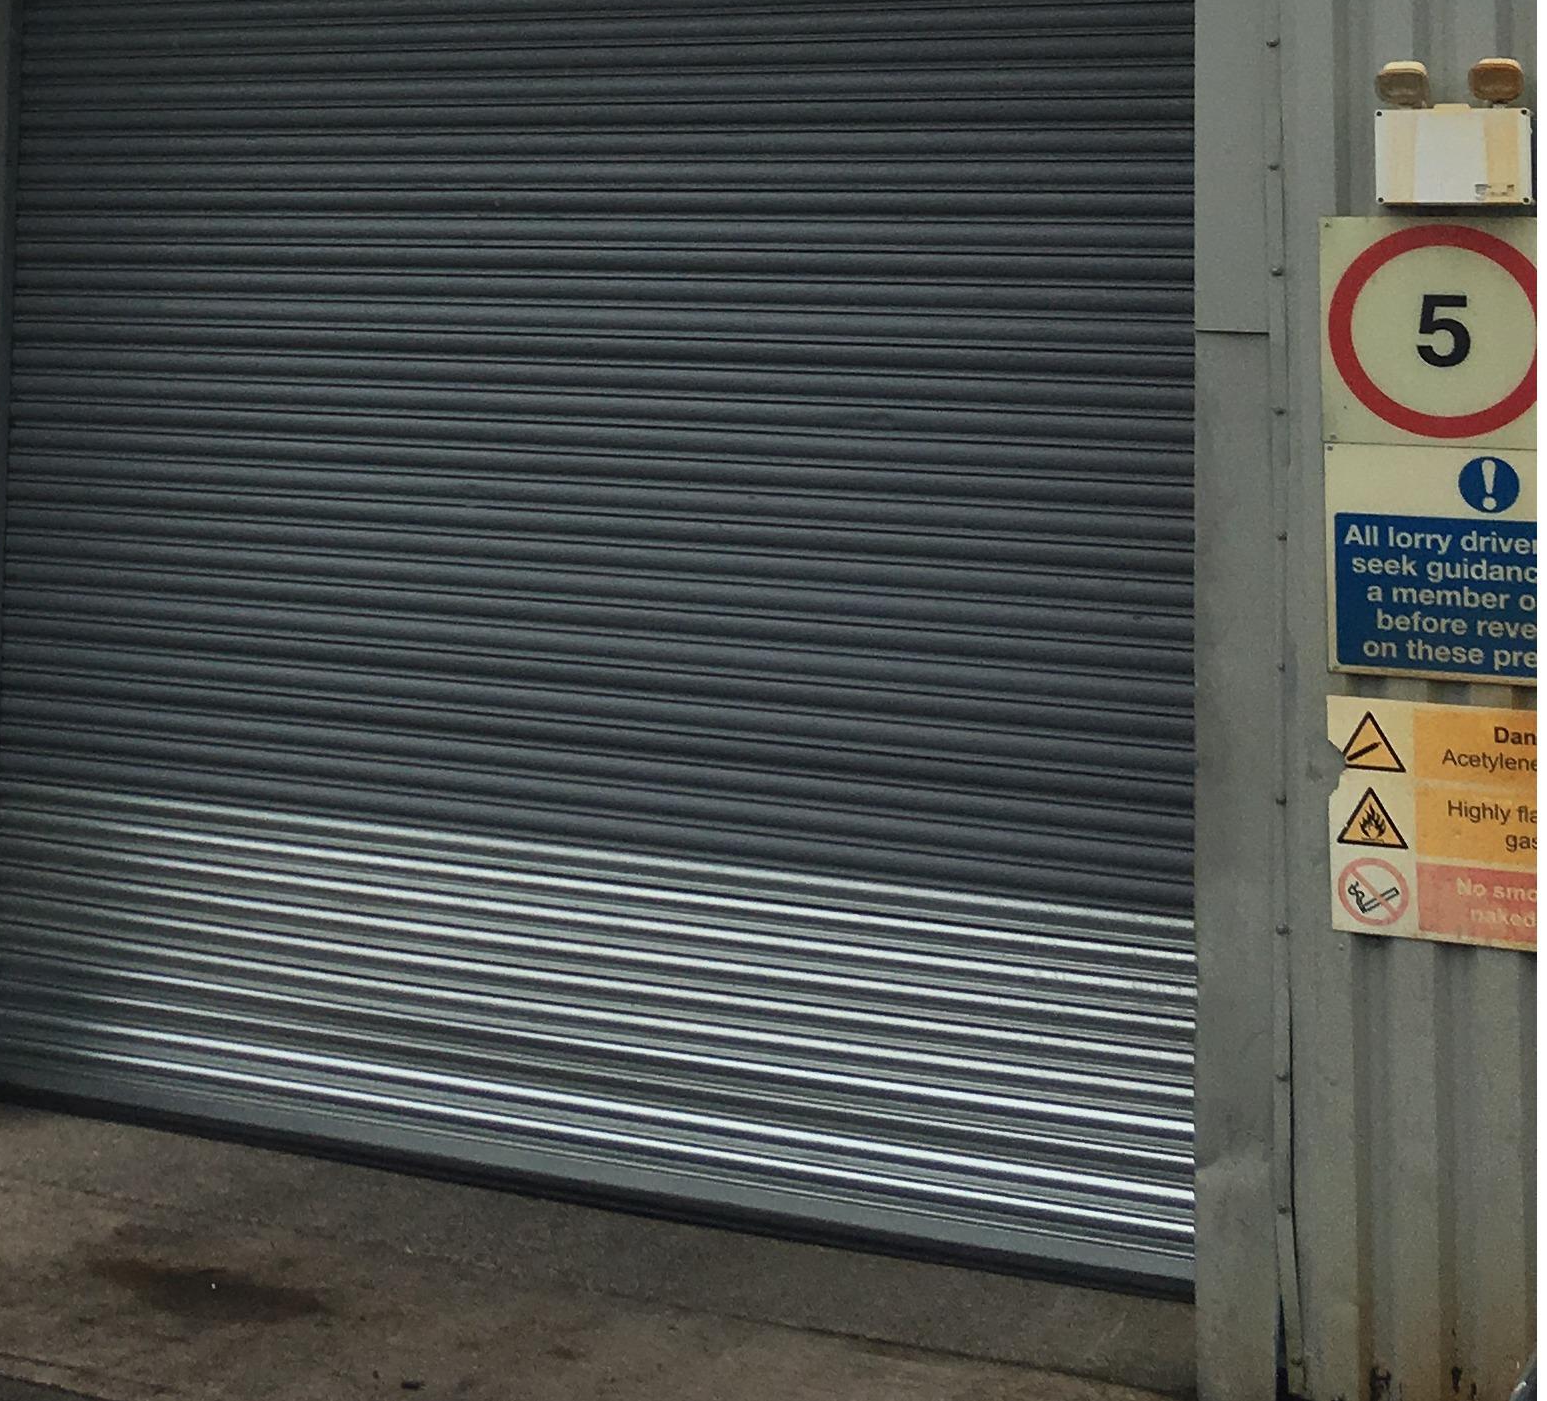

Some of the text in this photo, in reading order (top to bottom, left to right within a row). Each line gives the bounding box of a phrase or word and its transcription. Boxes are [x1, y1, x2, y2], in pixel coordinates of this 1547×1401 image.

[1416, 294, 1471, 368] 5
[1343, 524, 1379, 547] All
[1388, 526, 1453, 555] lorry
[1352, 554, 1537, 584] seek guidanc
[1366, 585, 1383, 603] a
[1392, 586, 1511, 610] member
[1376, 608, 1537, 640] before reve
[1363, 639, 1537, 671] on these pre
[1494, 726, 1537, 746] Dan
[1442, 748, 1537, 773] Acetylene
[1448, 800, 1511, 825] Highly
[1456, 877, 1487, 897] No
[1470, 907, 1537, 928] naked
